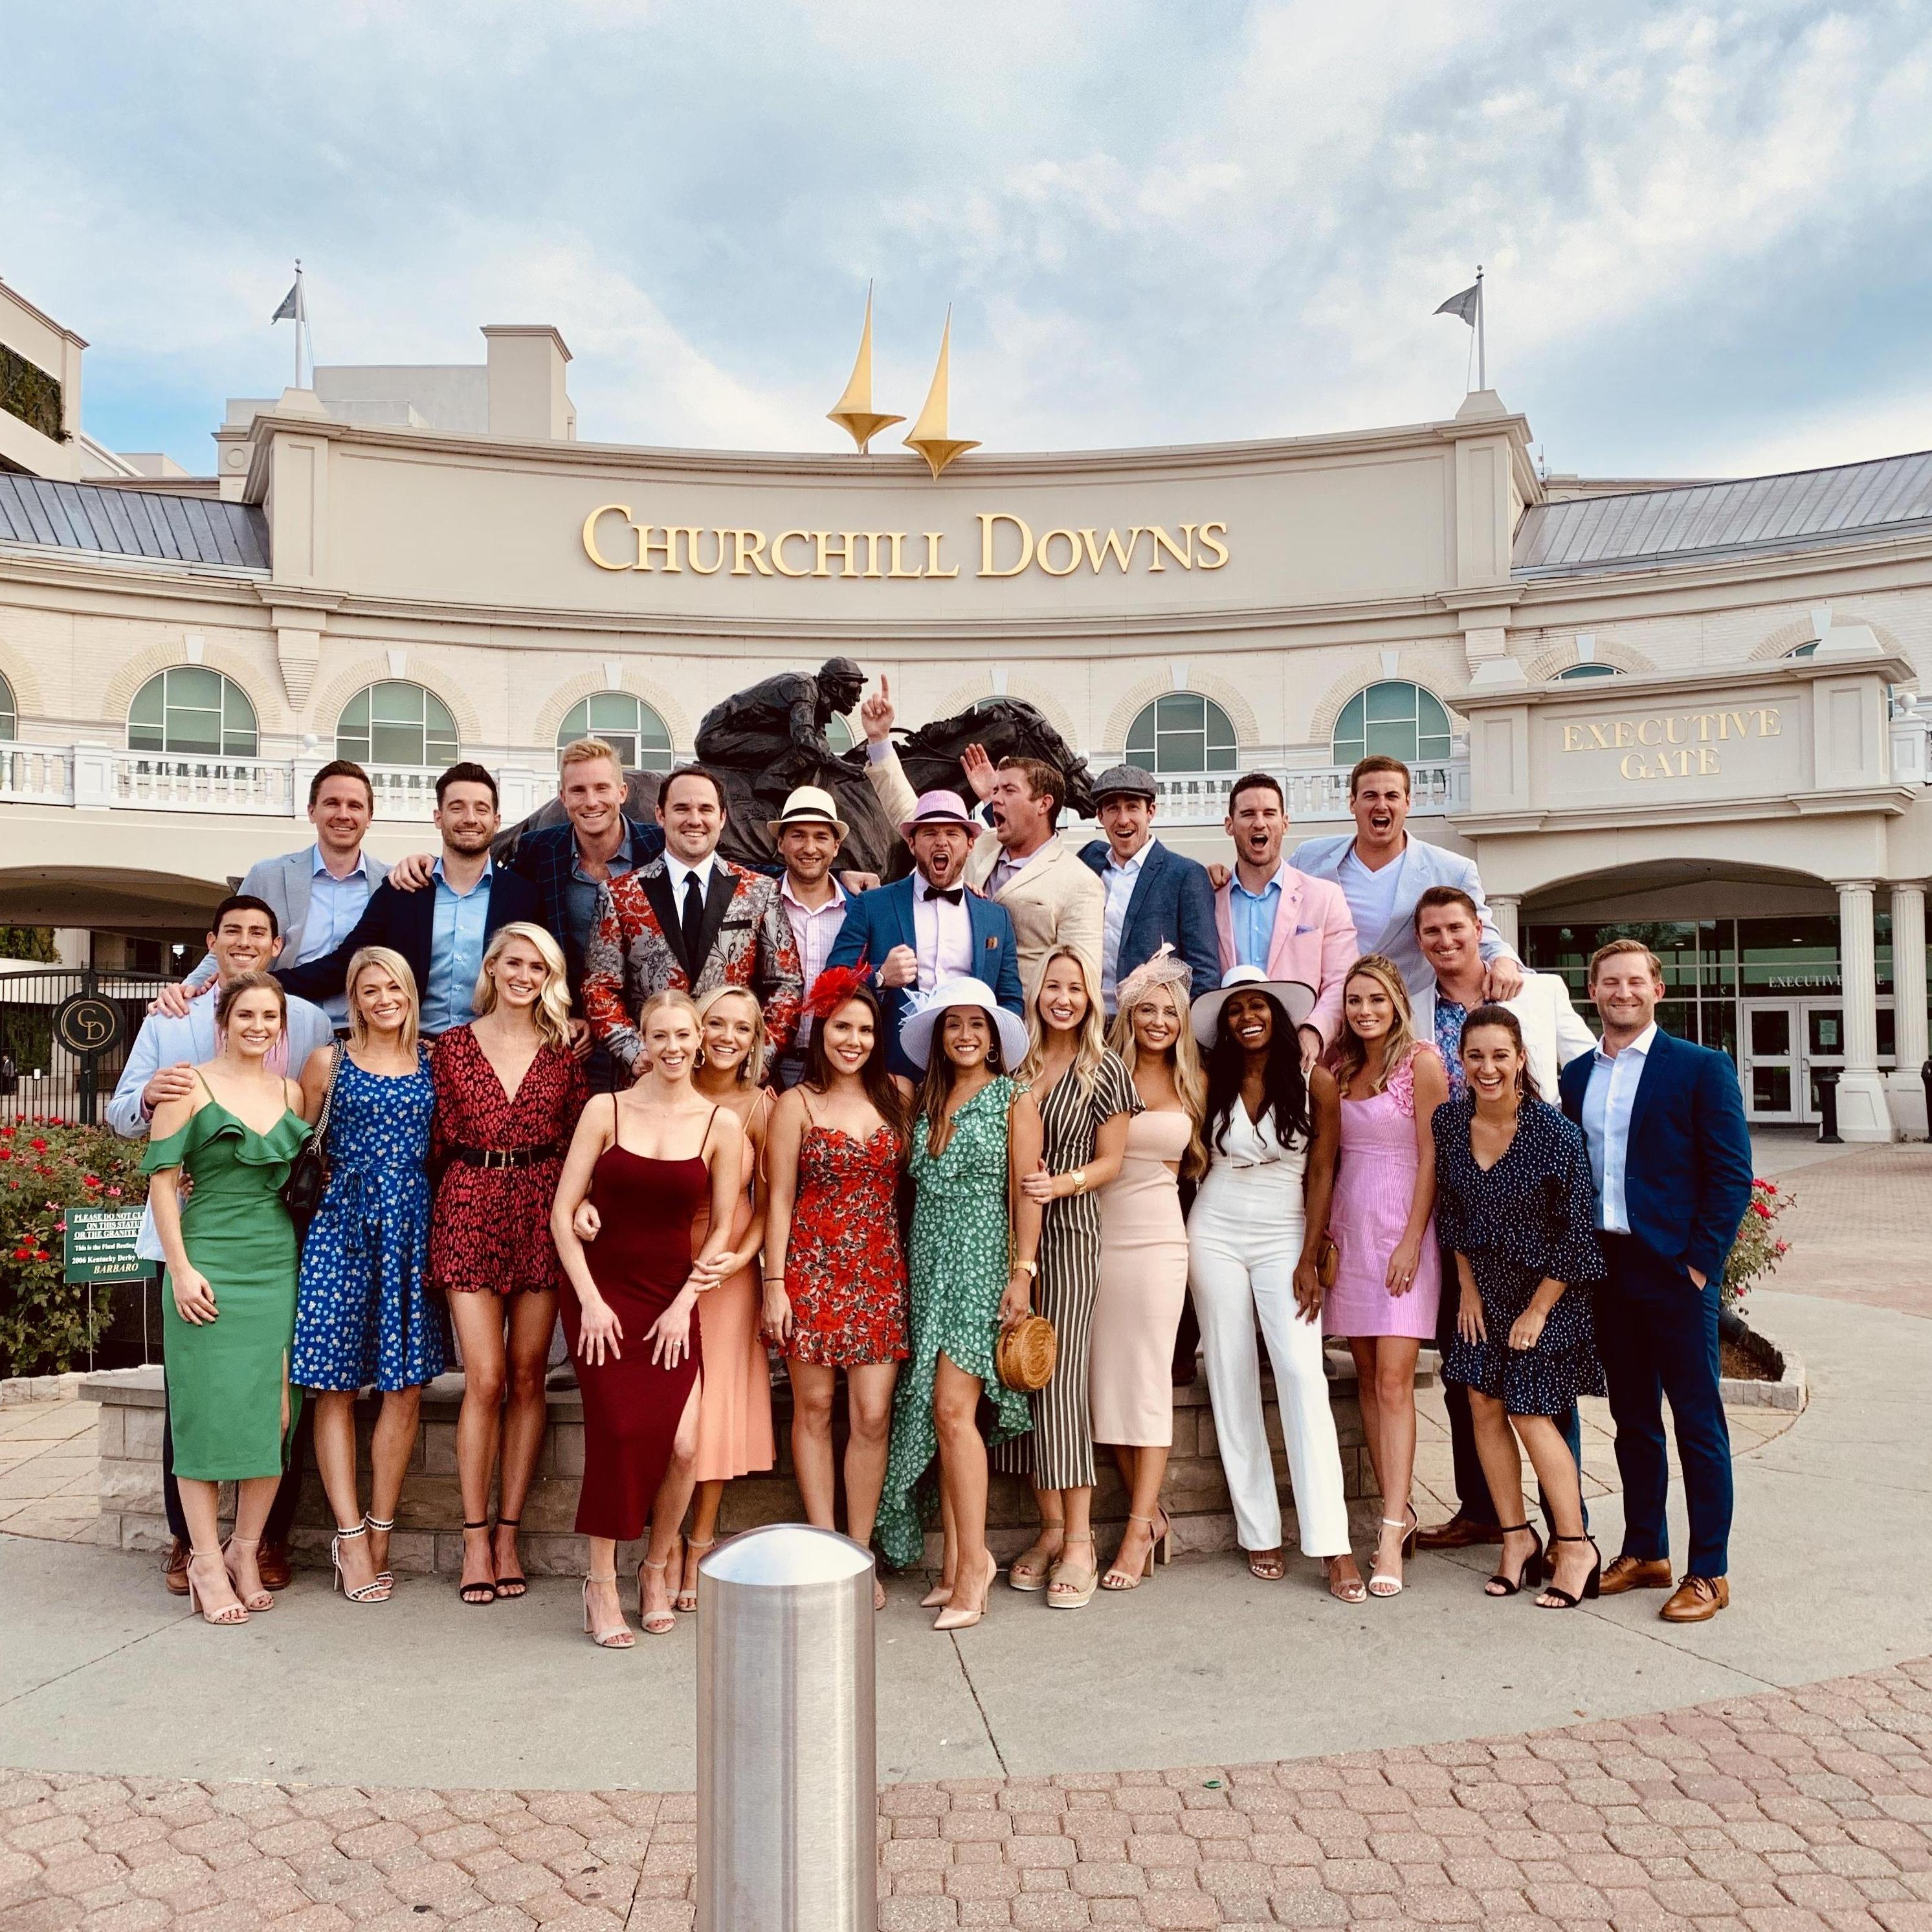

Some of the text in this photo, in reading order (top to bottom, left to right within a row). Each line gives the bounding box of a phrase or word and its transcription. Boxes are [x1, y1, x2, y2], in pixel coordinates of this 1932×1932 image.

[583, 505, 1229, 578] CHURCHILL DOWNS
[1562, 709, 1782, 751] EXECUTIVE
[1620, 748, 1721, 780] GATE
[87, 1255, 117, 1263] Kentucky
[117, 1254, 135, 1262] Derby
[93, 1263, 139, 1274] BARBARO
